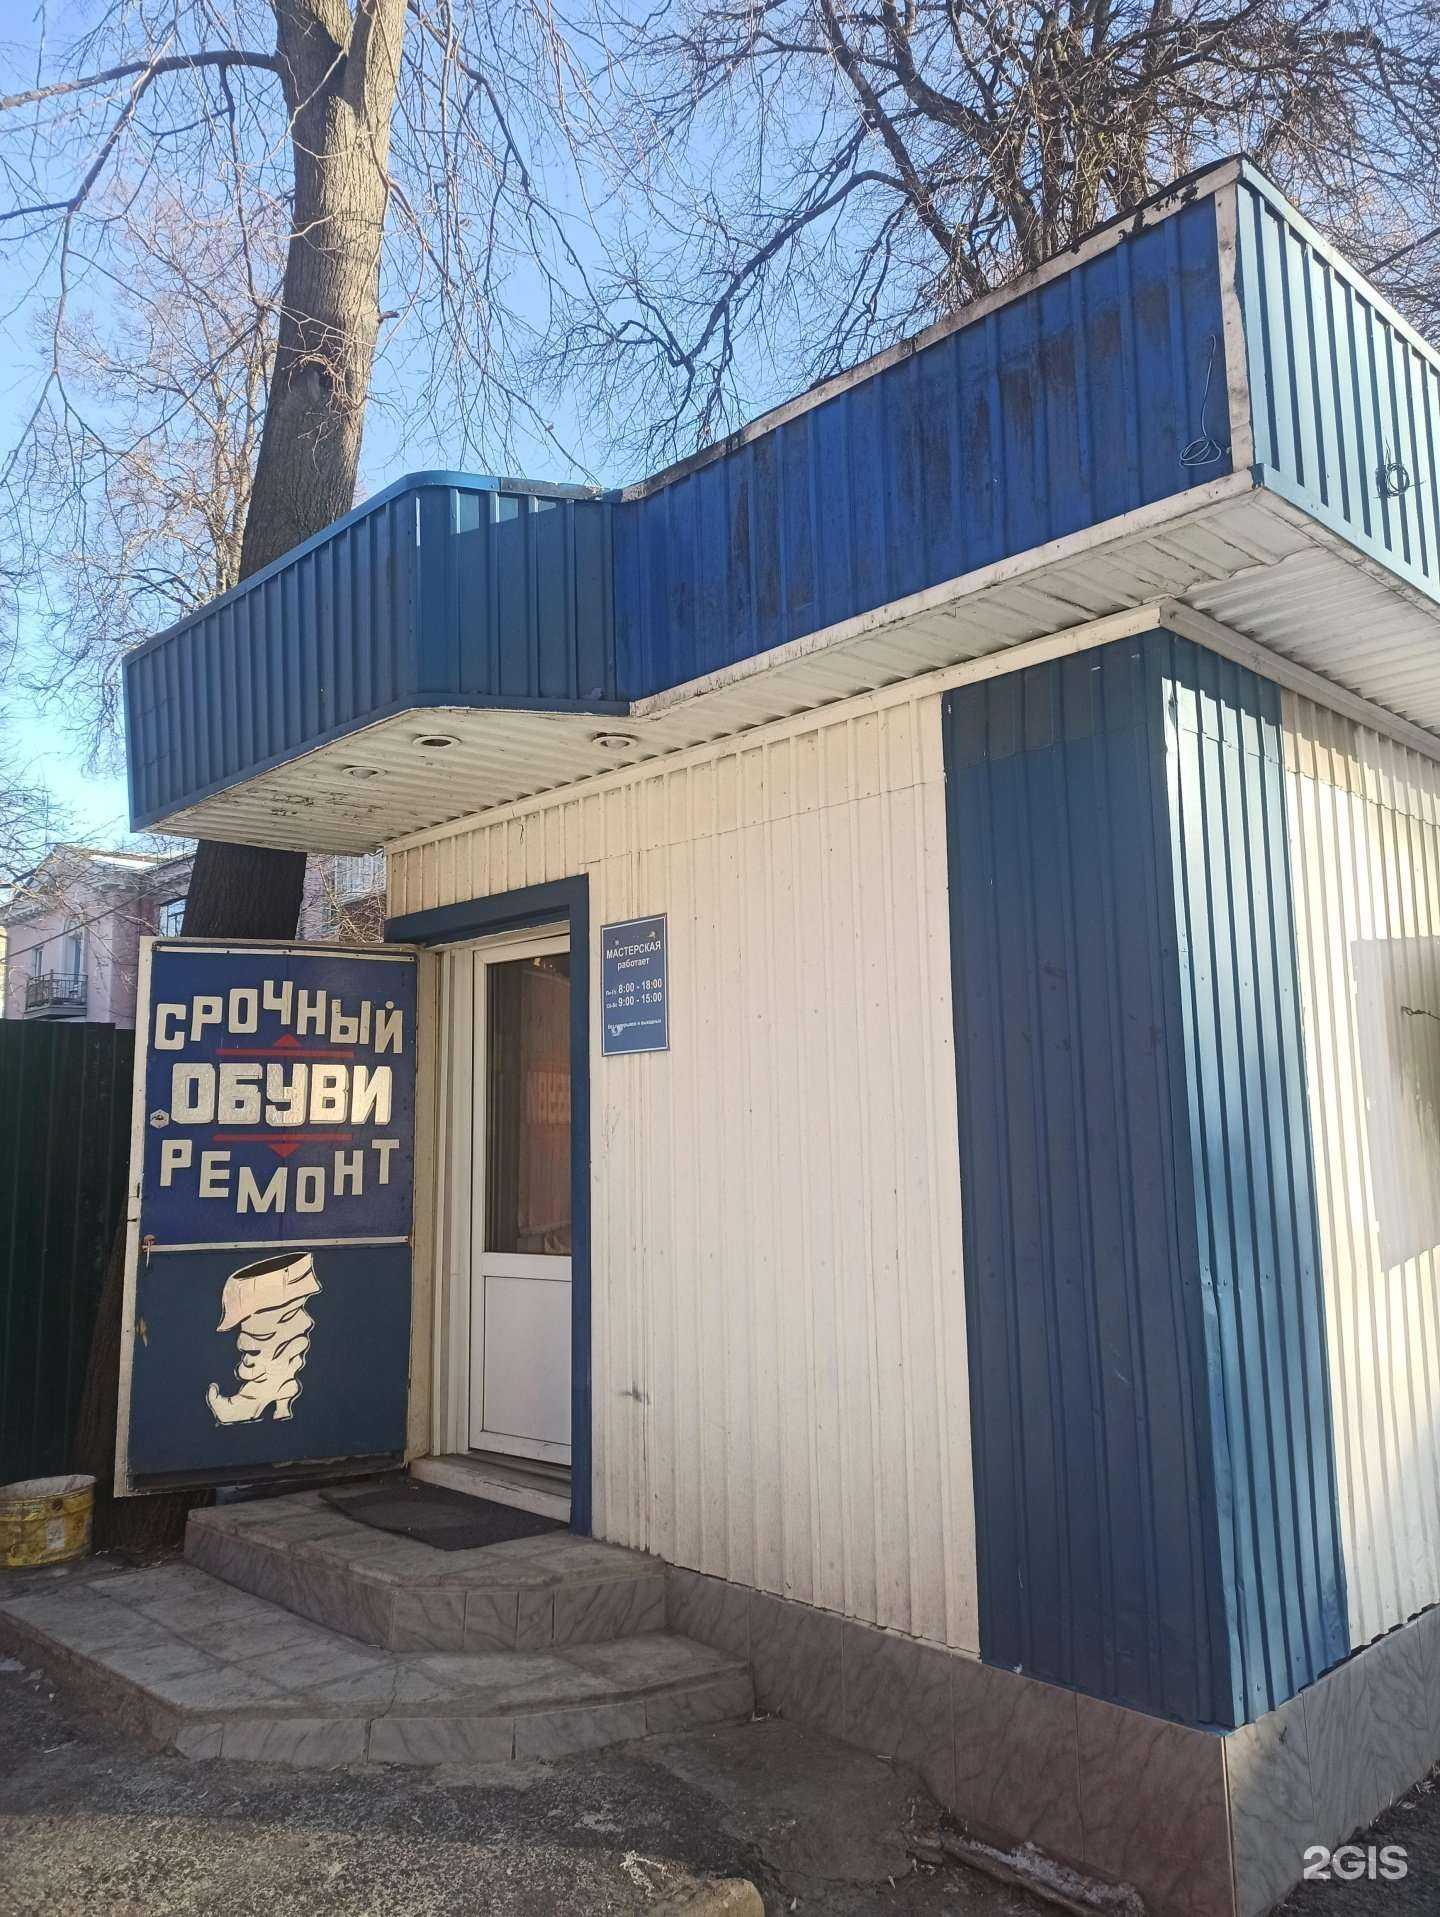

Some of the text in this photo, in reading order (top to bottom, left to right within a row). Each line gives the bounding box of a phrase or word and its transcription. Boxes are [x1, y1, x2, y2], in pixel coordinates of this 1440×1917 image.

[606, 940, 661, 959] МАСТЕРСКАЯ
[617, 958, 650, 973] работает
[618, 982, 635, 994] 8:00
[641, 978, 662, 990] 18:00
[618, 996, 635, 1007] 9:00
[641, 992, 662, 1004] 15:00
[154, 980, 404, 1054] СРОЧНЫЙ
[170, 1062, 393, 1127] ОБУВИ
[159, 1139, 400, 1214] РЕМОНТ
